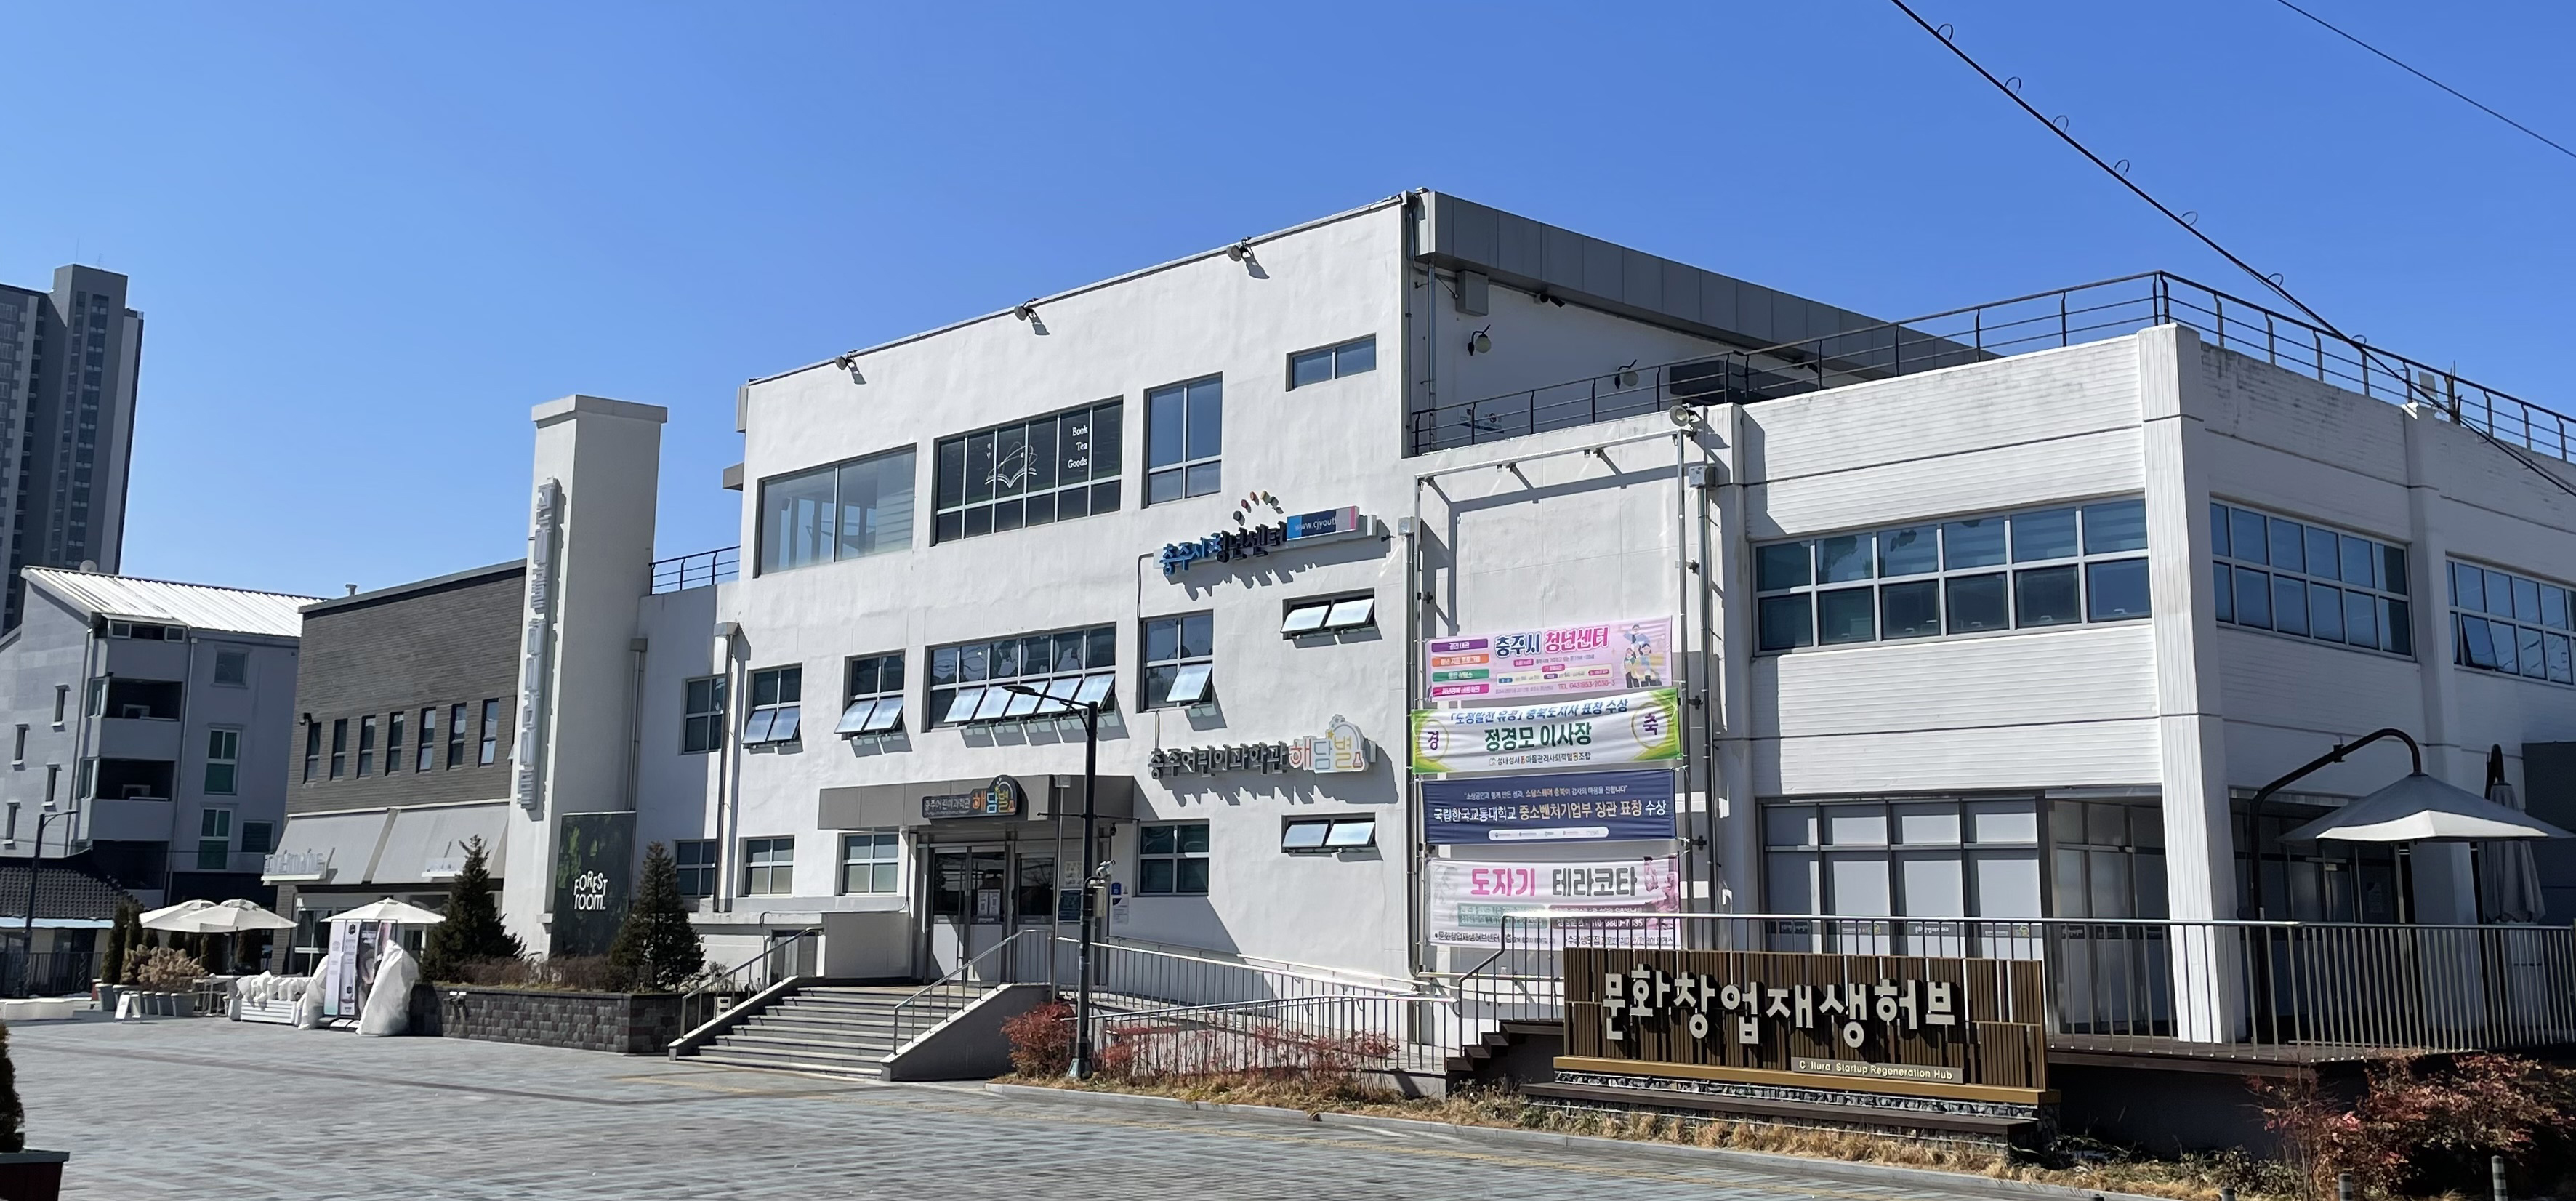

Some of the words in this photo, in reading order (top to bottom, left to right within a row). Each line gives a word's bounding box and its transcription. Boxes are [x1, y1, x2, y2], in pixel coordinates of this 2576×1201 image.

[1072, 425, 1088, 437] Book
[1076, 441, 1088, 451] Tea
[1068, 457, 1087, 469] Goods
[1495, 633, 1541, 657] 충주시
[1545, 626, 1610, 653] 청년센터
[1582, 700, 1603, 715] 표창
[1606, 698, 1628, 713] 수상
[1643, 713, 1658, 736] 축
[1428, 731, 1440, 750] 경
[1484, 726, 1534, 752] 정경모
[1540, 722, 1592, 747] 이사장
[1148, 739, 1289, 779] 충주어린이과학관
[1433, 807, 1516, 823] 국립한국교통대학교
[1519, 803, 1593, 821] 중소벤처기업부
[1595, 801, 1617, 818] 장관
[1620, 800, 1642, 816] 표창
[1645, 799, 1667, 814] 수상
[573, 870, 608, 896] FOREST
[1470, 867, 1536, 896] 도자기
[1552, 866, 1638, 897] 테라코타
[1602, 963, 1956, 1049] 문화창업재생허브
[1836, 1062, 1868, 1075] Startup
[1870, 1064, 1931, 1079] Regeneration
[1933, 1069, 1953, 1080] Hub
